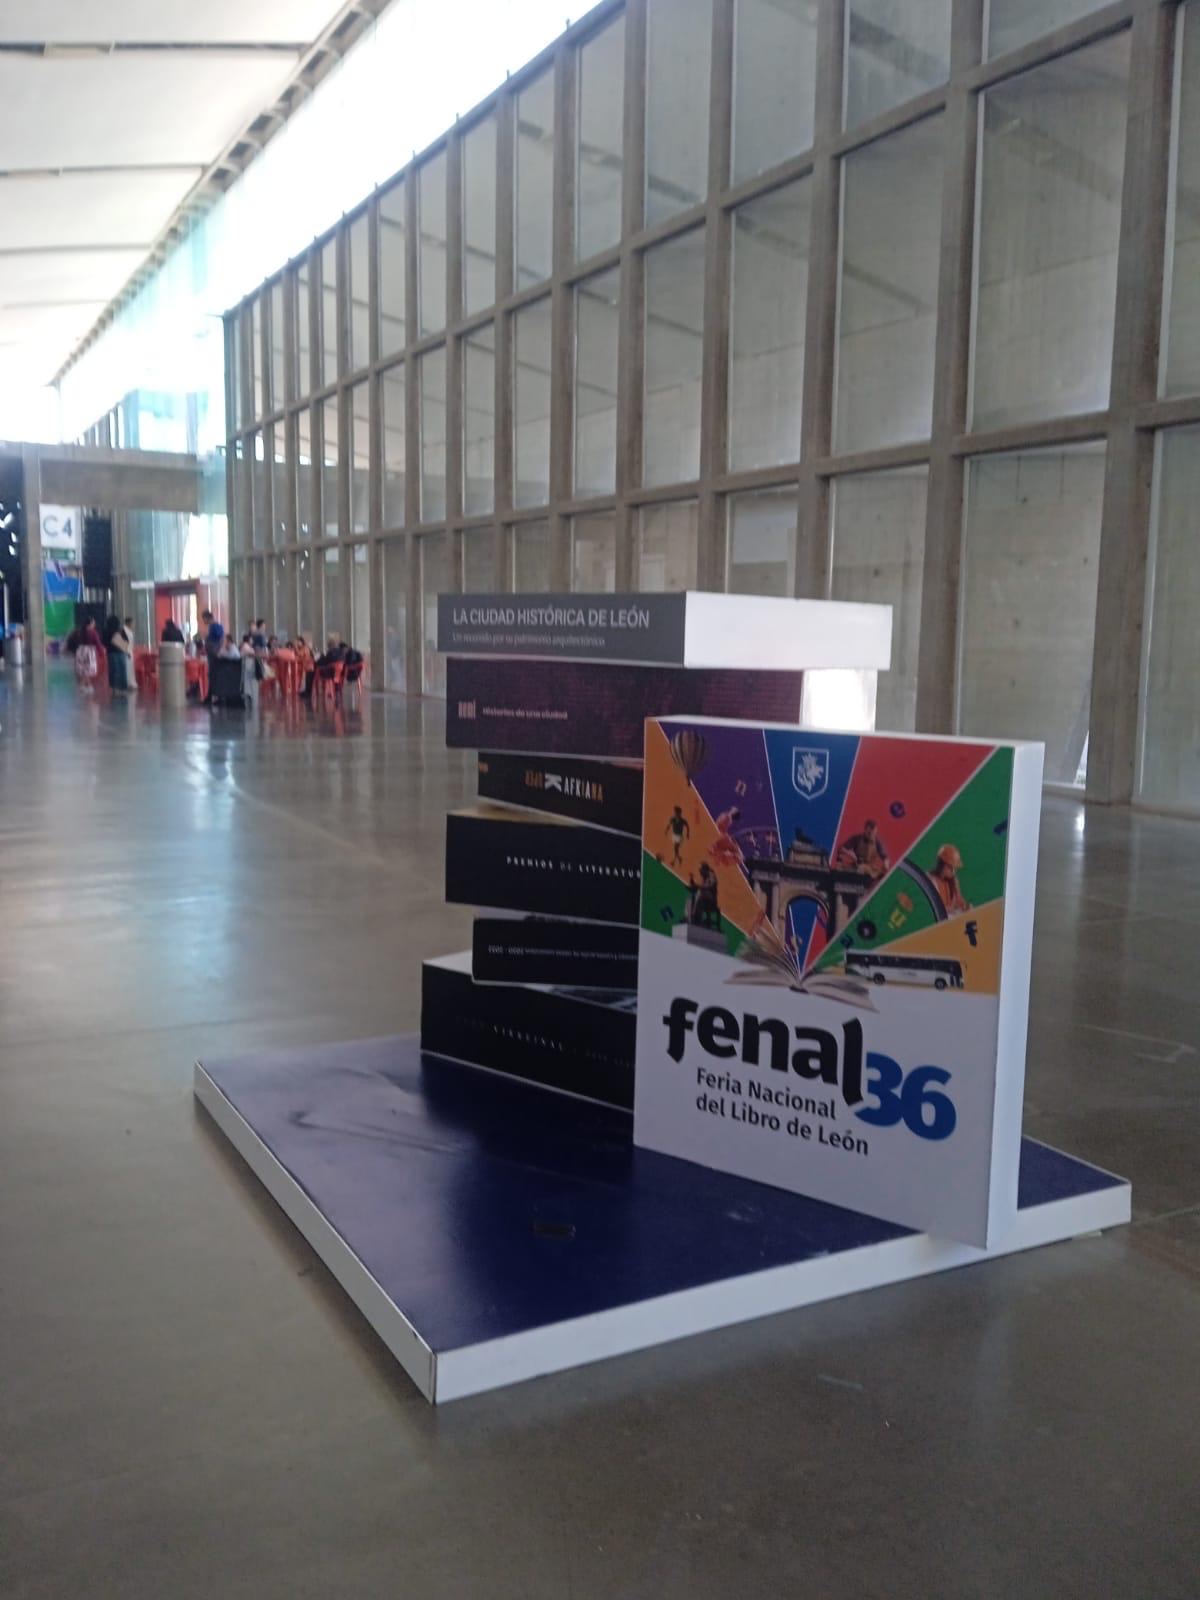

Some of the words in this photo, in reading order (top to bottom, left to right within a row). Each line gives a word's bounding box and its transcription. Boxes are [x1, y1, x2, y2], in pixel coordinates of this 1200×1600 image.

[453, 607, 469, 625] LA
[470, 608, 515, 626] CIUDAD
[517, 604, 585, 627] HISTÓRICA
[588, 610, 607, 627] DE
[610, 605, 650, 629] LEÓN
[506, 855, 554, 870] PREMIOS
[662, 997, 864, 1107] fenal
[697, 1067, 743, 1096] Feria
[749, 1079, 837, 1120] Nacional
[854, 1051, 957, 1142] 36
[696, 1093, 726, 1117] del
[731, 1103, 780, 1131] Libro
[786, 1117, 812, 1140] de
[818, 1126, 869, 1156] León
